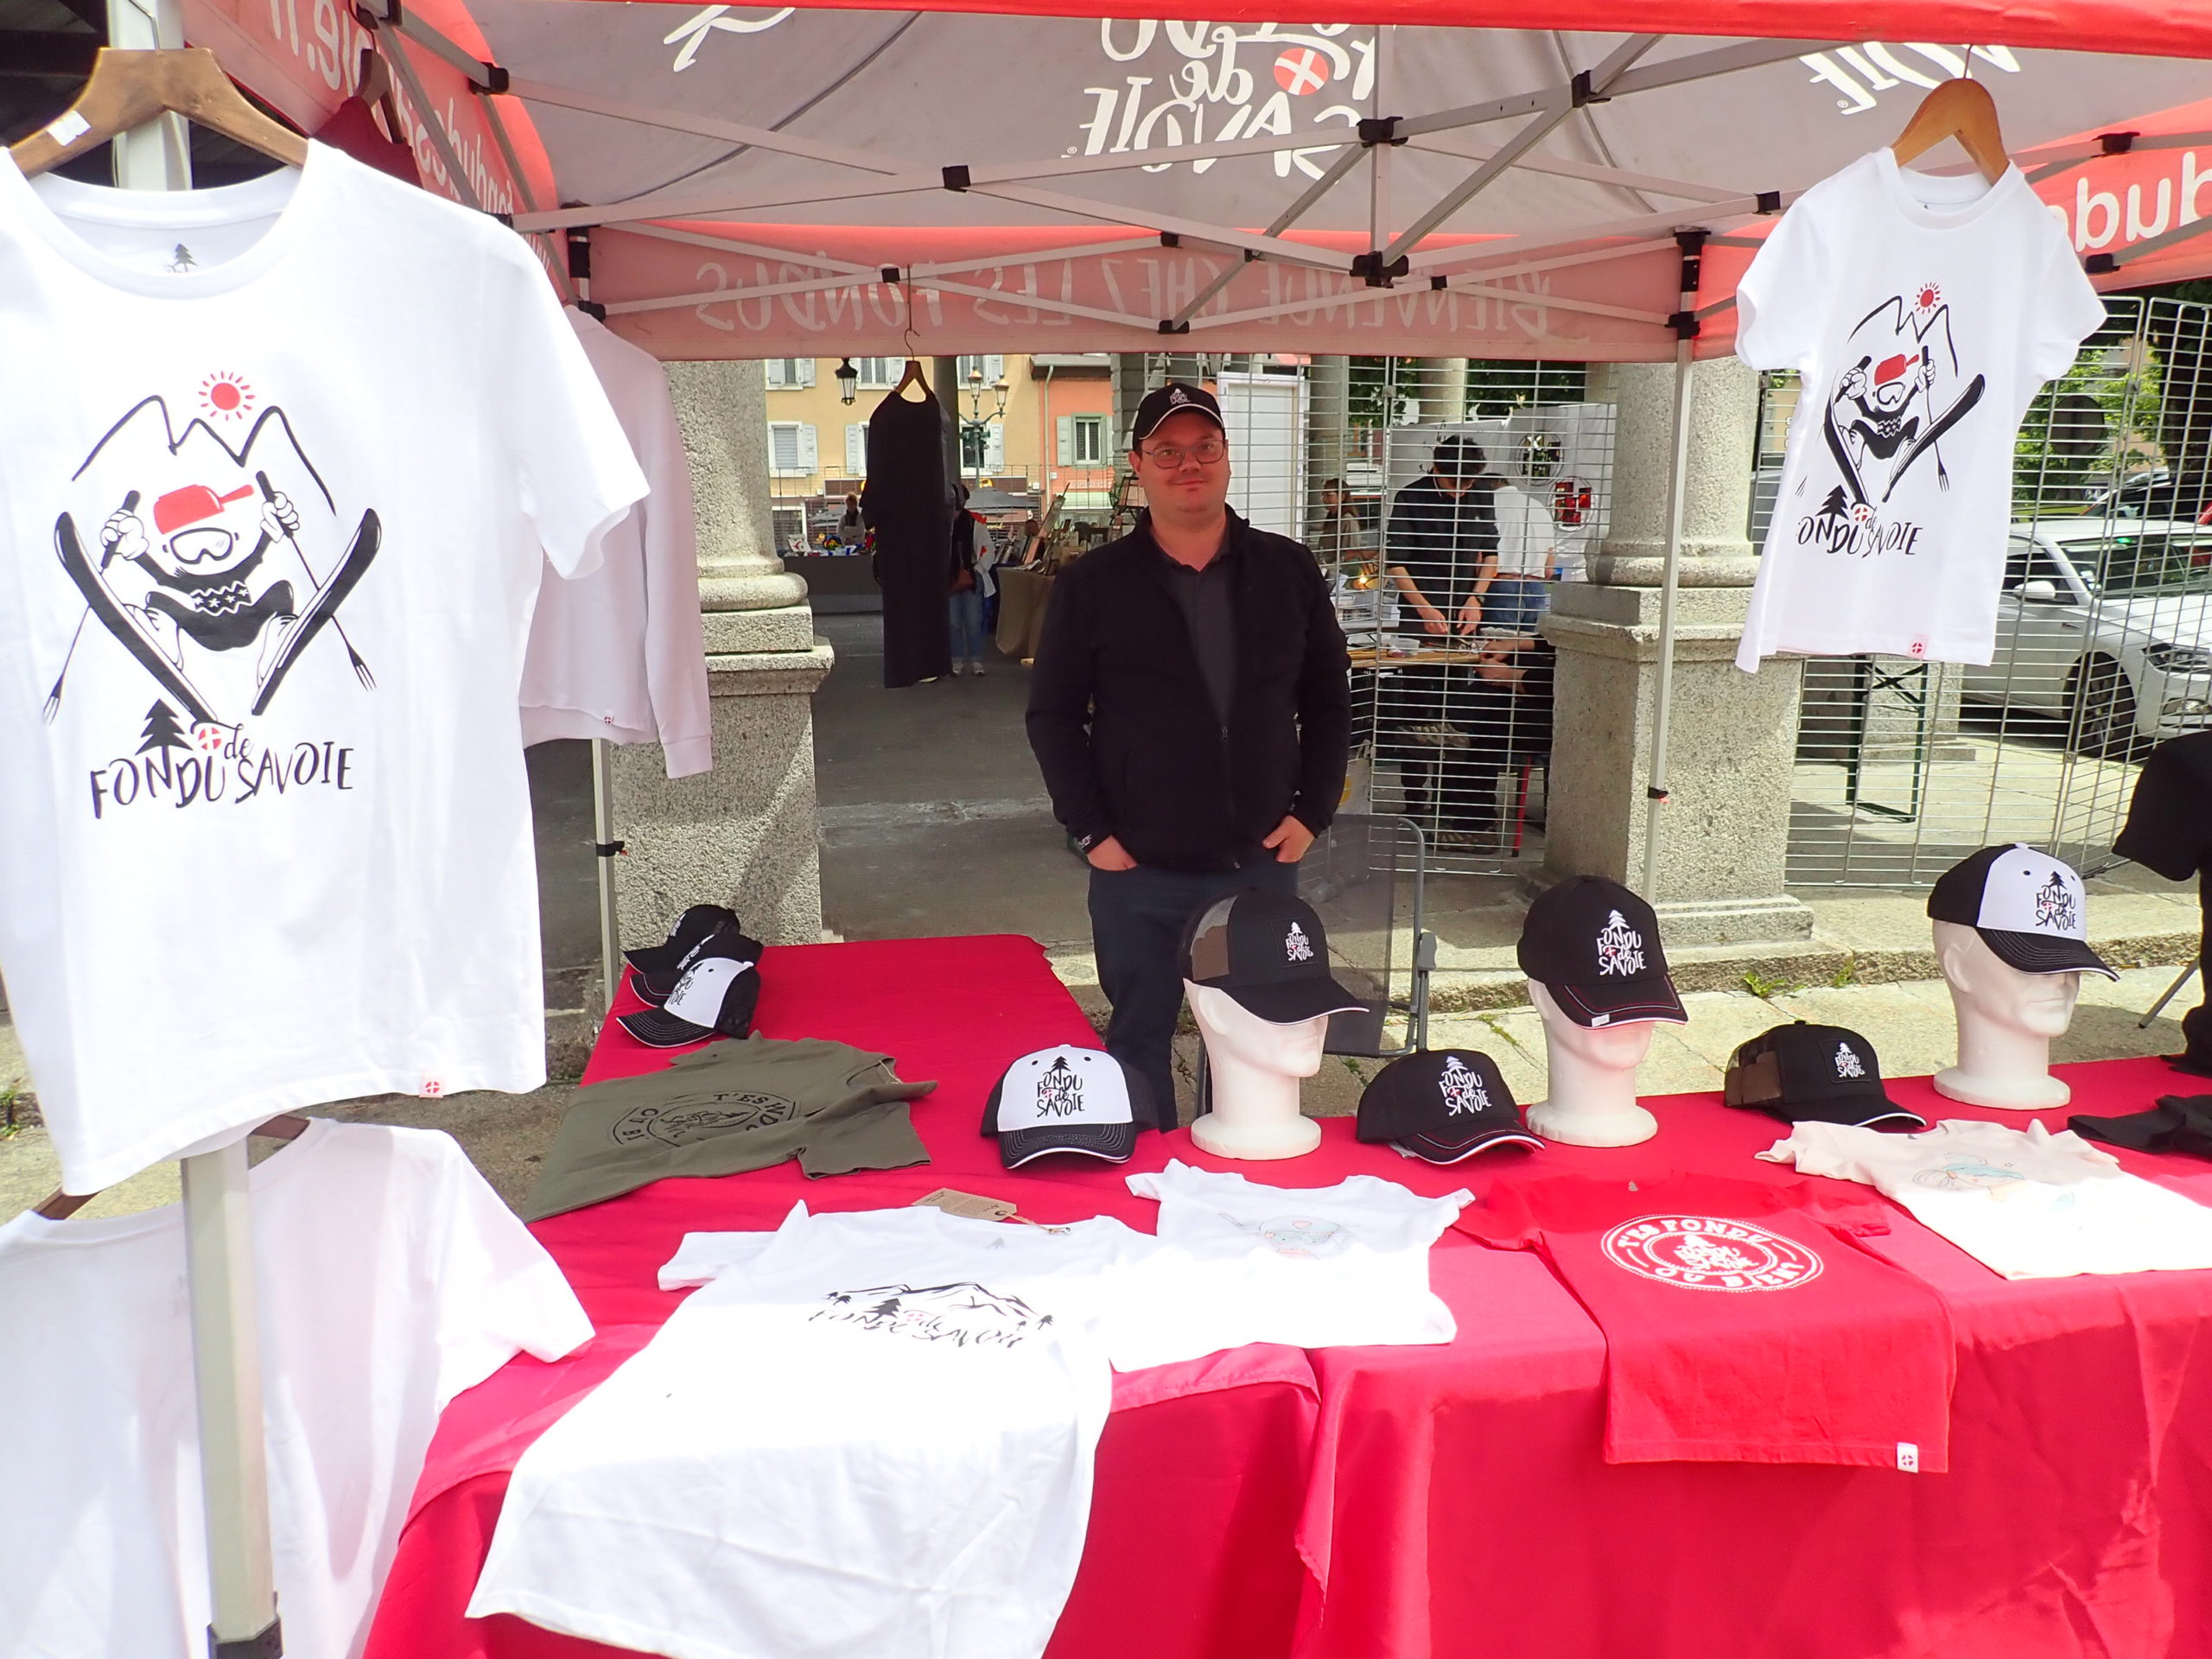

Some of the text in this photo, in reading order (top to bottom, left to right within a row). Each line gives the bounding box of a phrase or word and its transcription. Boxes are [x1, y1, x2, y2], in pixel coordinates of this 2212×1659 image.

[1796, 516, 1864, 555] ONDU
[90, 748, 226, 819] FONDU
[235, 741, 354, 804] SAVOIE
[2036, 884, 2076, 908] FONDU
[2036, 911, 2076, 931] SAVOIE
[1597, 927, 1642, 956] FONDU
[1599, 951, 1647, 976] SAVOIE
[1037, 1071, 1083, 1098] FONDU
[1439, 1071, 1483, 1097] FONDU
[1037, 1093, 1085, 1118] SAVOIE
[1446, 1090, 1492, 1116] SAVOIE
[1661, 1218, 1773, 1244] FONDU
